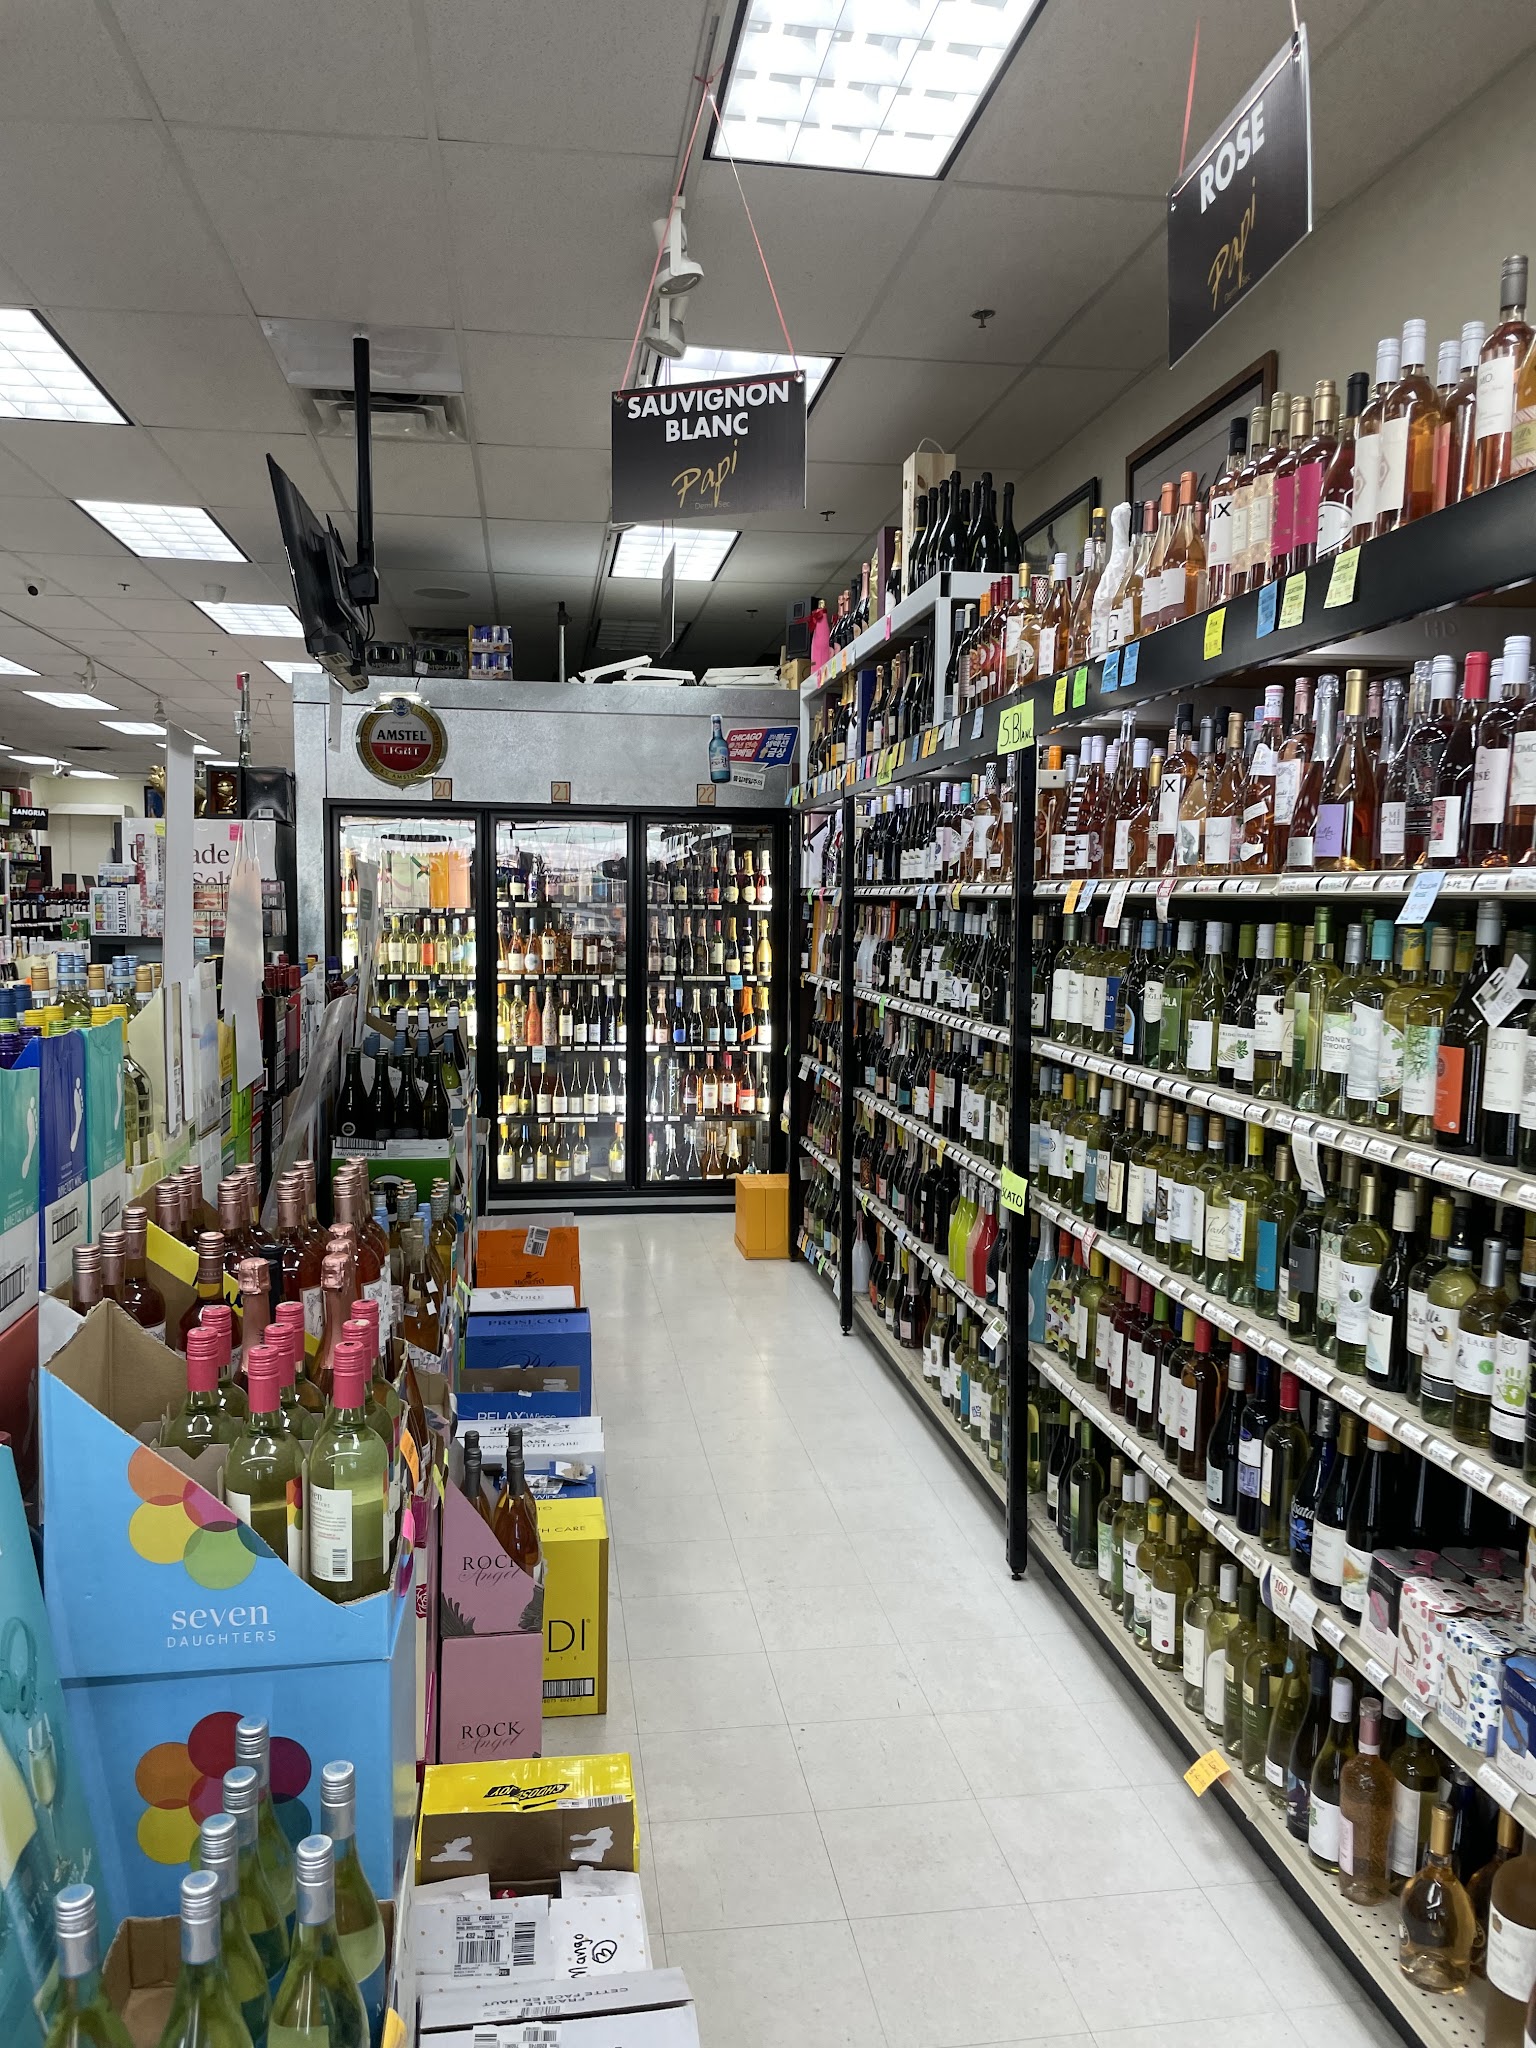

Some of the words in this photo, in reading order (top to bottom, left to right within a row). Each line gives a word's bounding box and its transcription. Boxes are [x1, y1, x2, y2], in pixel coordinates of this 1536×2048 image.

[1200, 100, 1265, 214] ROSE
[1207, 176, 1256, 312] Papi
[627, 380, 789, 419] SAUVIGNON
[665, 412, 749, 443] BLANC
[671, 438, 739, 509] Papi
[1213, 501, 1232, 520] IX
[376, 730, 427, 741] AMSTEL
[730, 732, 763, 742] CHICAGO
[434, 781, 451, 797] 20
[552, 783, 570, 800] 21
[698, 786, 715, 802] 22
[12, 808, 46, 817] SANGRIA
[116, 890, 127, 935] CUTWATER
[1323, 1042, 1351, 1051] STRONG
[1002, 1186, 1023, 1208] SCATO
[487, 1317, 569, 1327] PROSECCO
[554, 1525, 586, 1533] CARE
[1274, 1579, 1288, 1597] 100
[171, 1604, 270, 1630] seven
[166, 1629, 277, 1649] DAUGHTERS
[461, 1720, 520, 1740] ROCK
[457, 1727, 525, 1754] Angel
[522, 1995, 541, 2004] EN
[544, 1992, 581, 2001] FACE
[584, 1987, 629, 1997] CETTE
[481, 1998, 519, 2008] HAUT
[524, 1996, 586, 2008] FRAGILE
